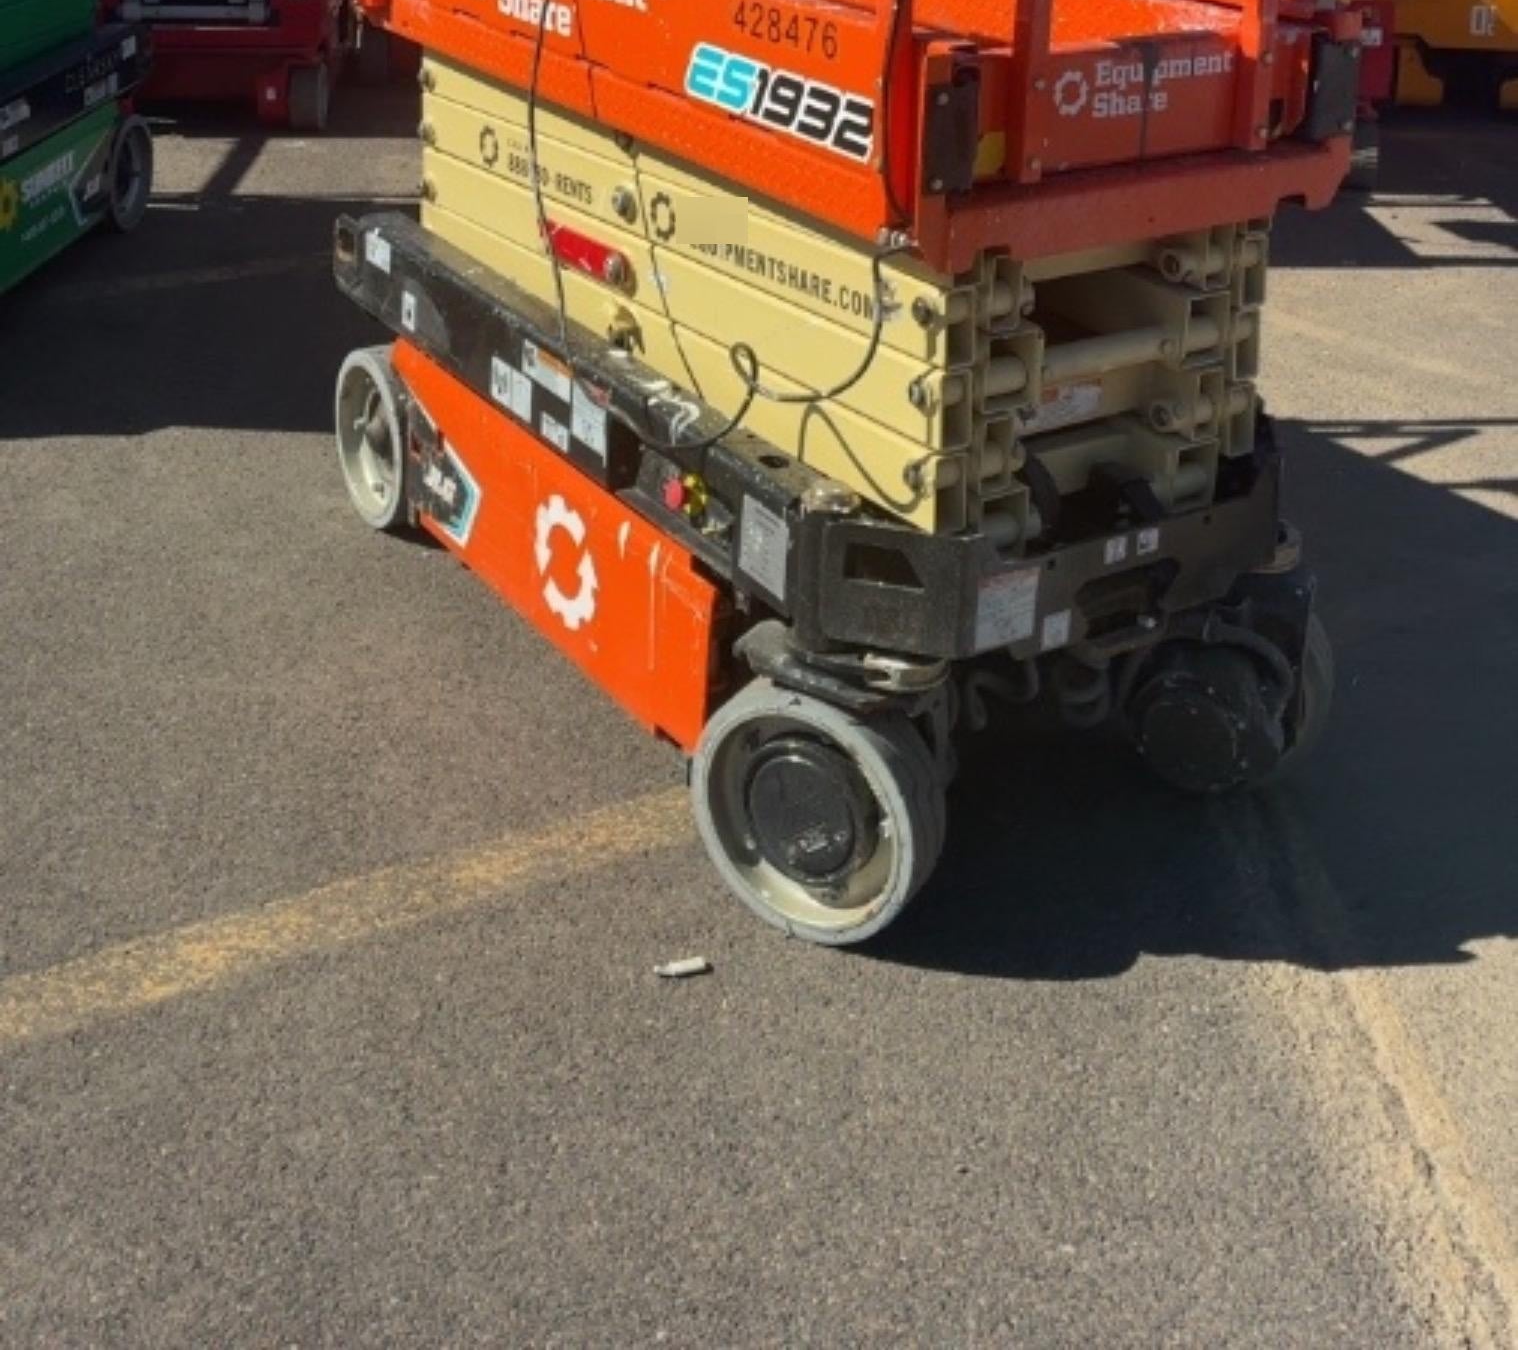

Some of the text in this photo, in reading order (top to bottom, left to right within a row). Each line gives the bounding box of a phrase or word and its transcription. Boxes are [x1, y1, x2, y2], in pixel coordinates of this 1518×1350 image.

[733, 0, 839, 60] 428476
[1094, 51, 1234, 91] Equpment
[686, 42, 874, 162] ES1932
